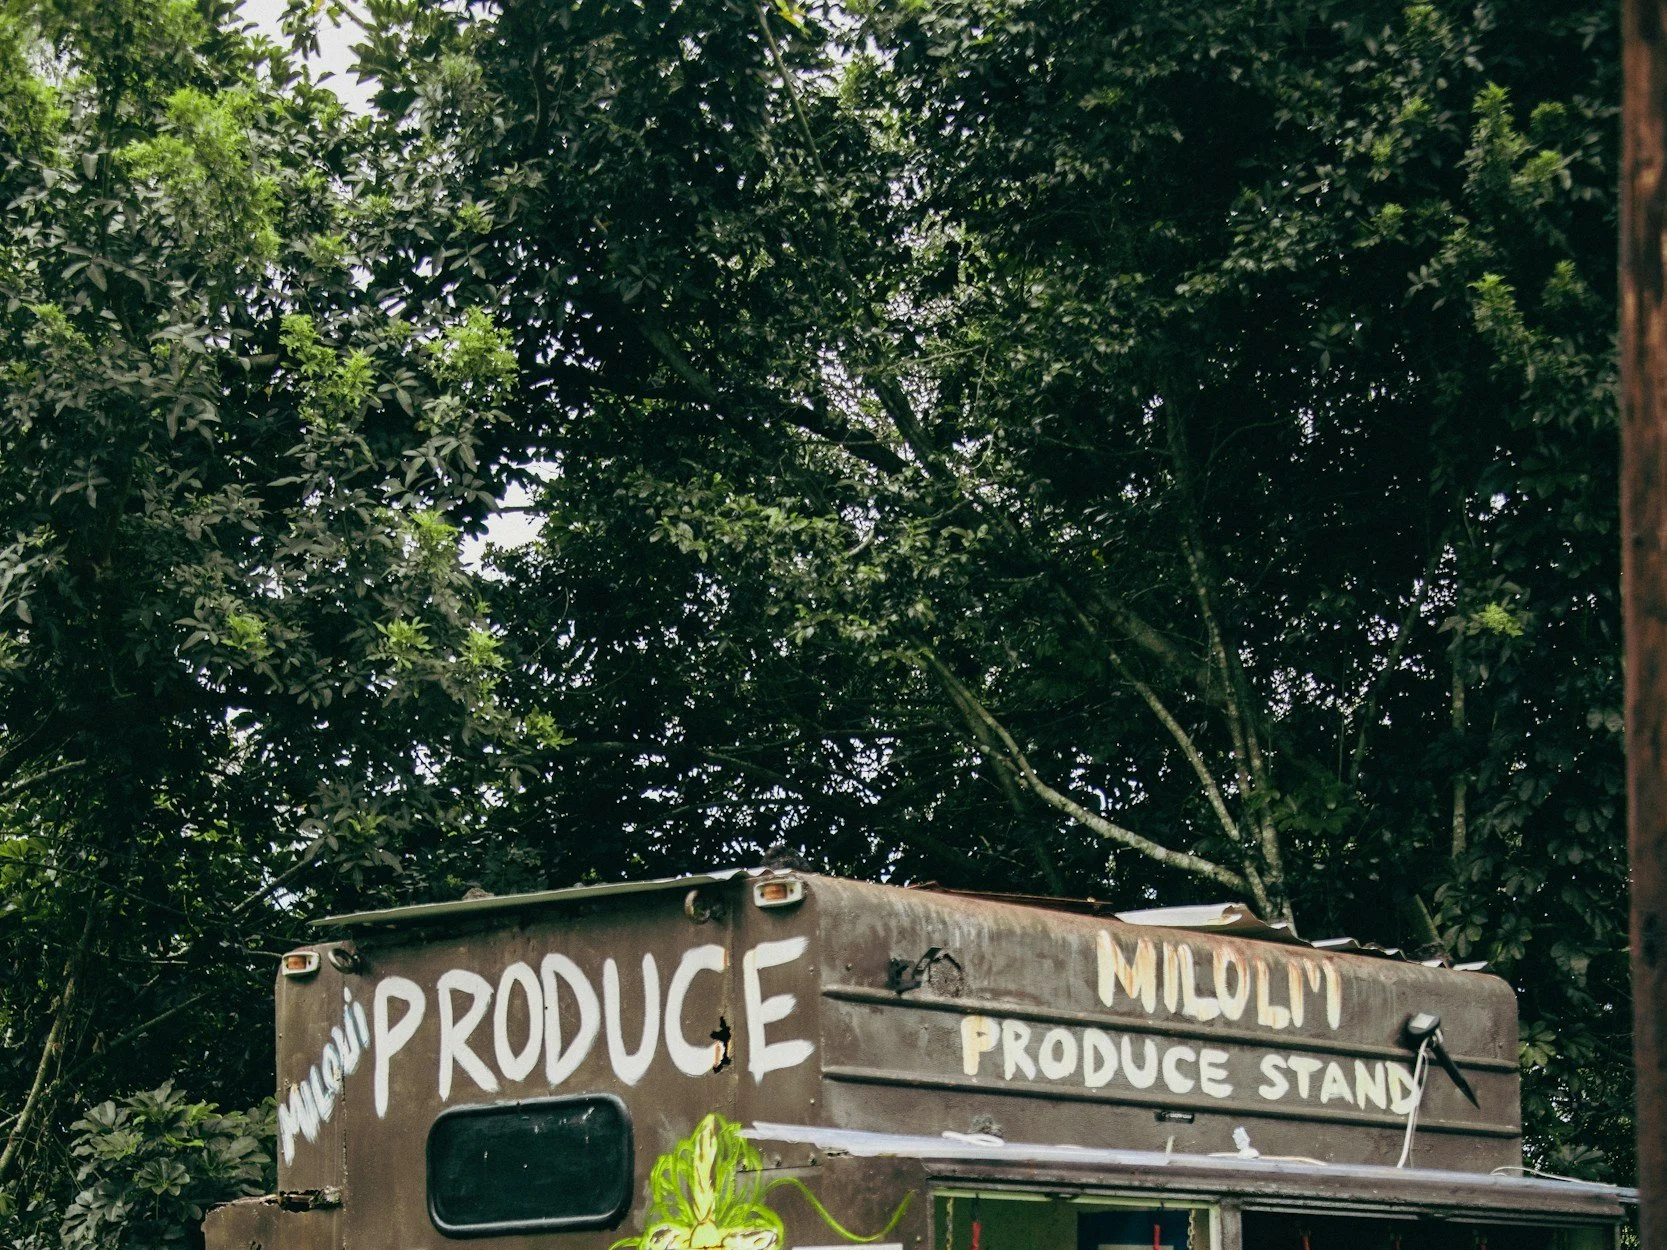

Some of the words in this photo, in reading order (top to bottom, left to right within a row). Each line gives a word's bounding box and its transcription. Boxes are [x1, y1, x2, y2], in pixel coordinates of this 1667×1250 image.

[374, 936, 815, 1118] PRODUCE
[960, 1015, 1234, 1099] PRODUCE
[1258, 1053, 1419, 1115] STAND
